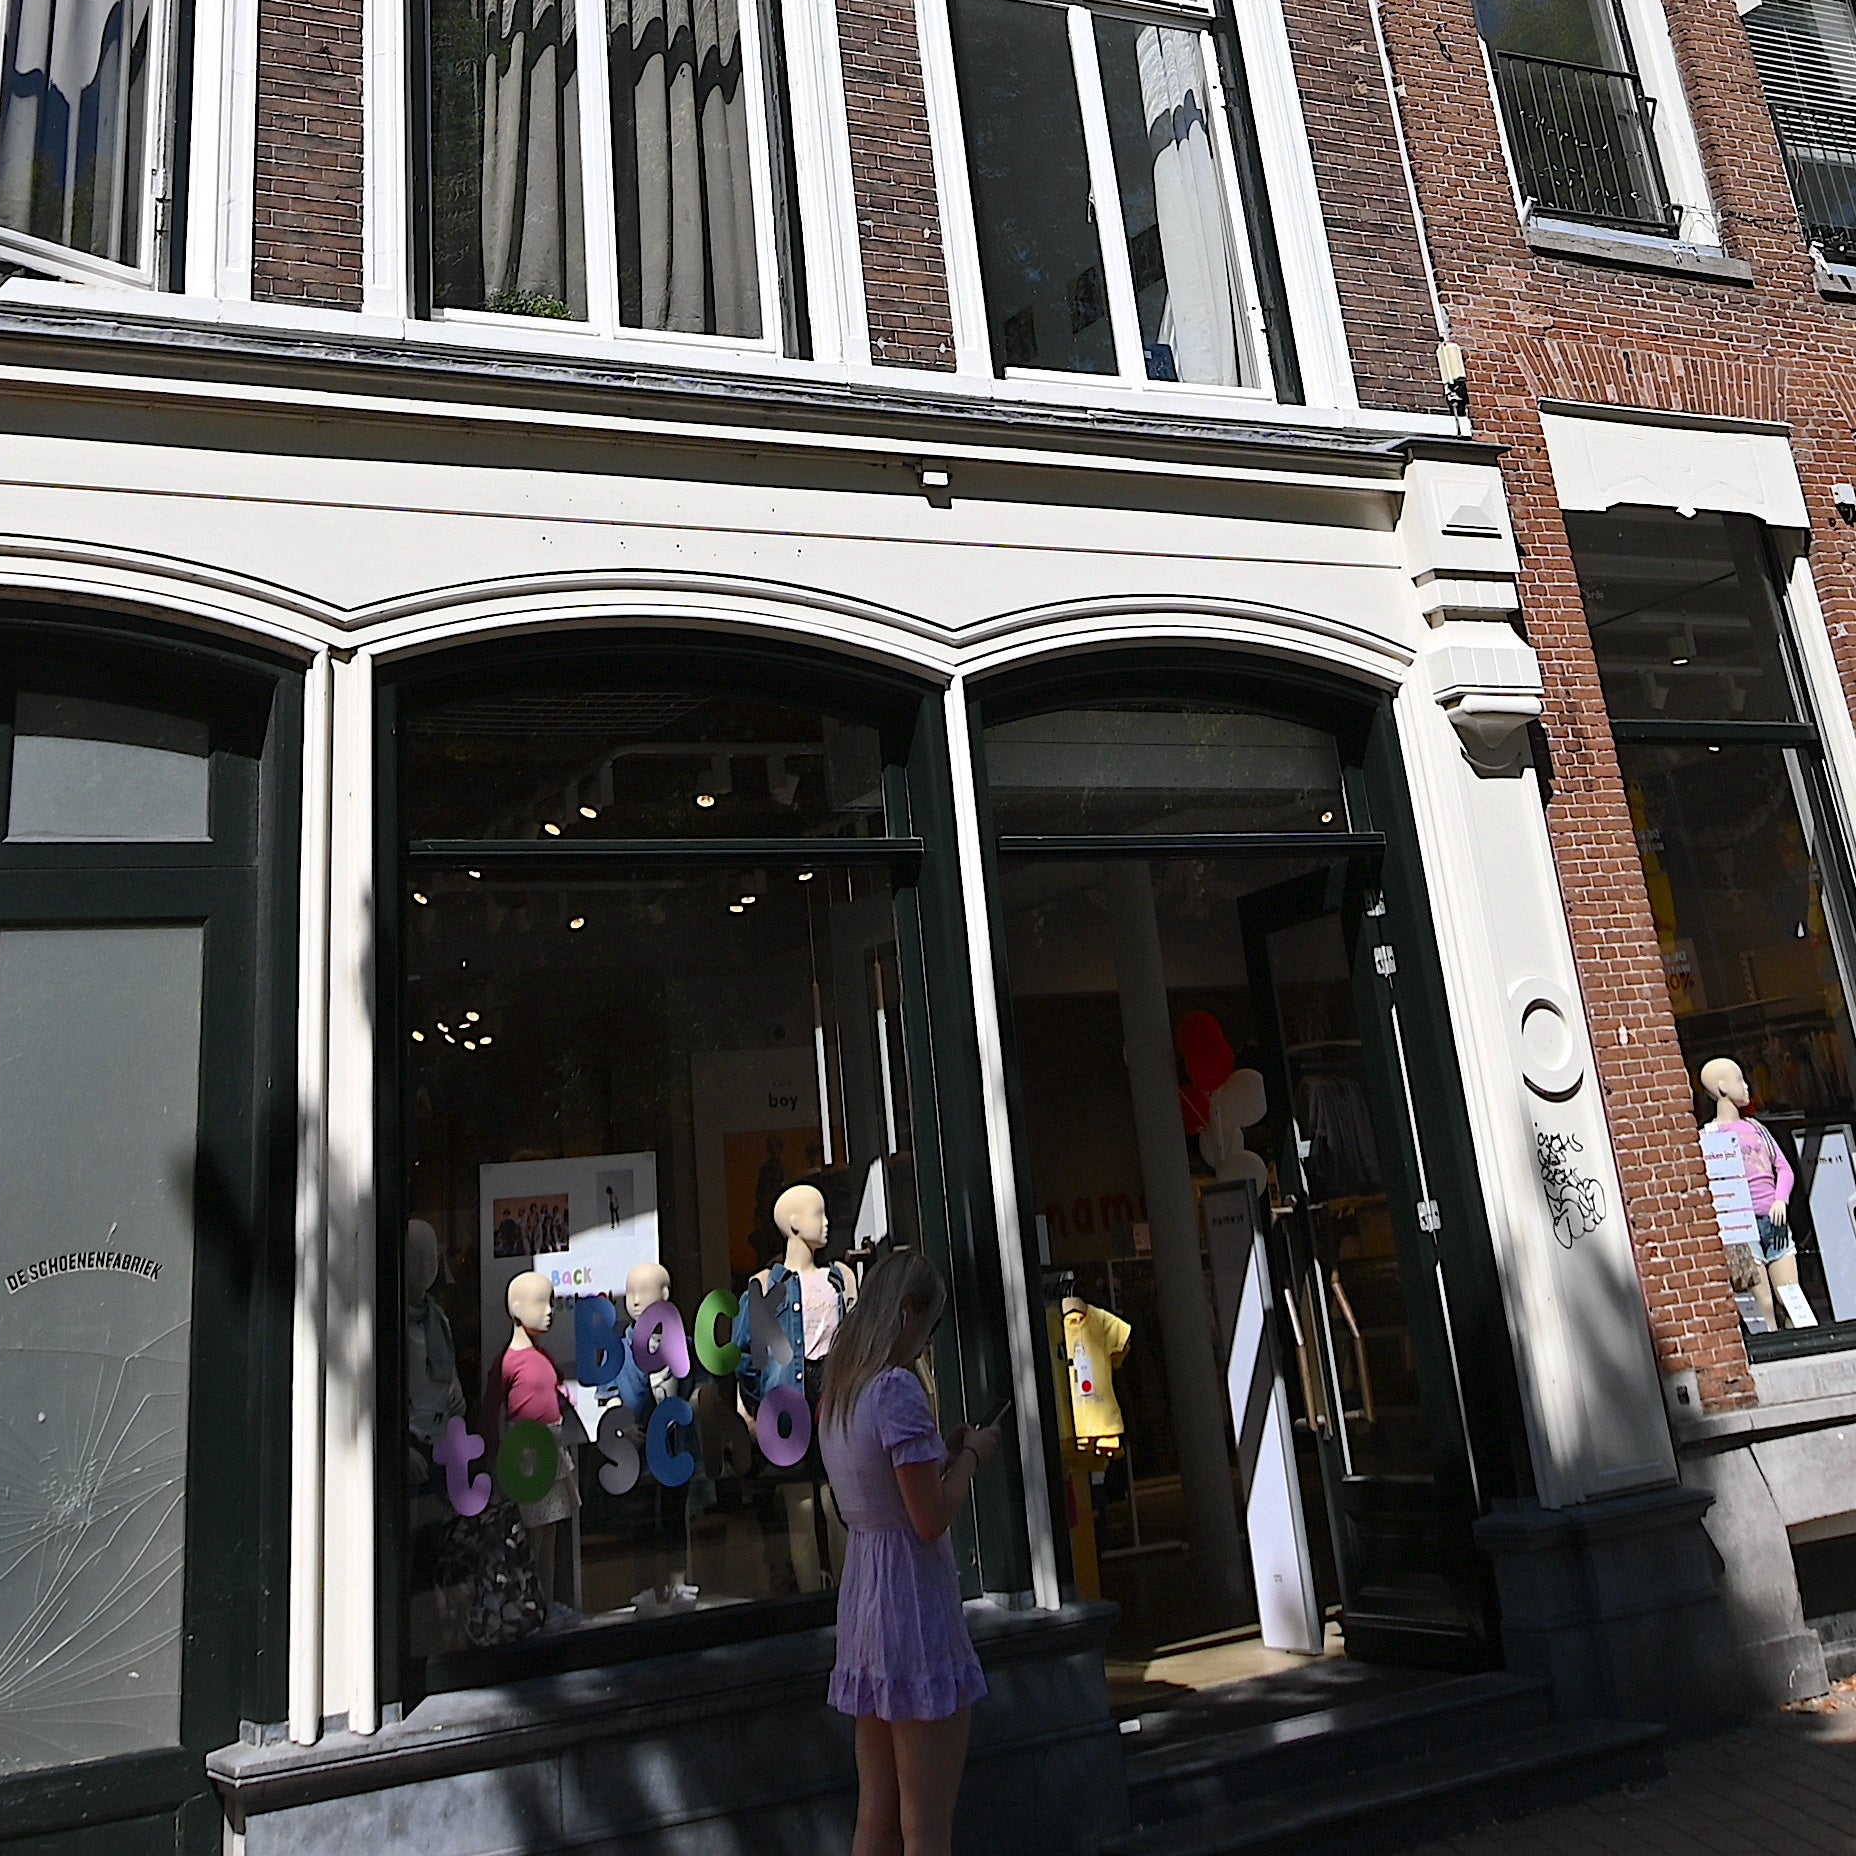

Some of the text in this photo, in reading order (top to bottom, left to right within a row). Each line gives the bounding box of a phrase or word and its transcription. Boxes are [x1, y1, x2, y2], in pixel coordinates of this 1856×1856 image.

[768, 1092, 798, 1111] boy
[4, 1250, 164, 1295] DE SCHOENENFABRIEK
[432, 1415, 558, 1517] to
